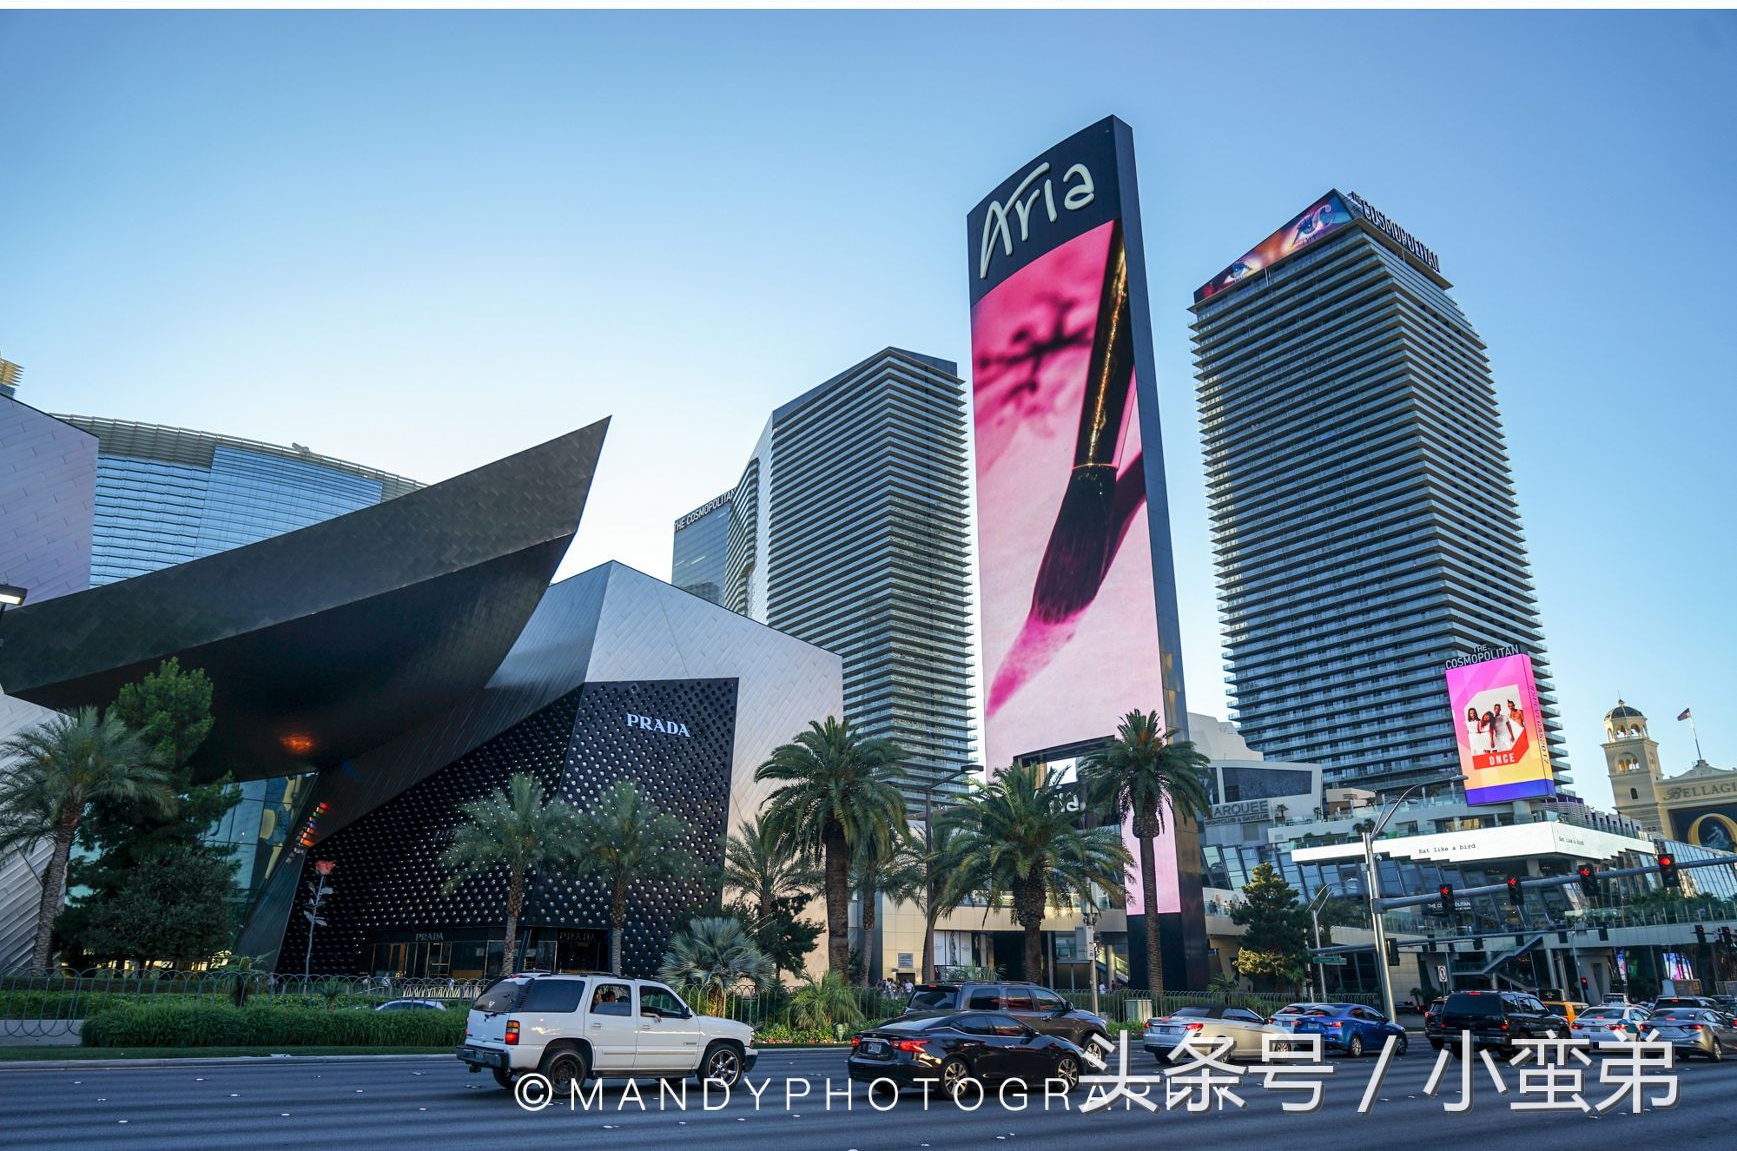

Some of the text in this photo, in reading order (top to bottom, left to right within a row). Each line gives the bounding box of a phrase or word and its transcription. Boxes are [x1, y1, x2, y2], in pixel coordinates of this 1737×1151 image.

[979, 161, 1095, 280] Aria
[1361, 200, 1441, 273] COSMOPOLITAN
[674, 519, 686, 533] THE
[1472, 643, 1488, 653] THE
[1445, 644, 1520, 670] COSMOPOLITAN
[626, 712, 691, 738] PRADA
[1489, 752, 1515, 766] ONCE
[1213, 800, 1269, 816] ARQUEE
[415, 932, 444, 941] PRADA
